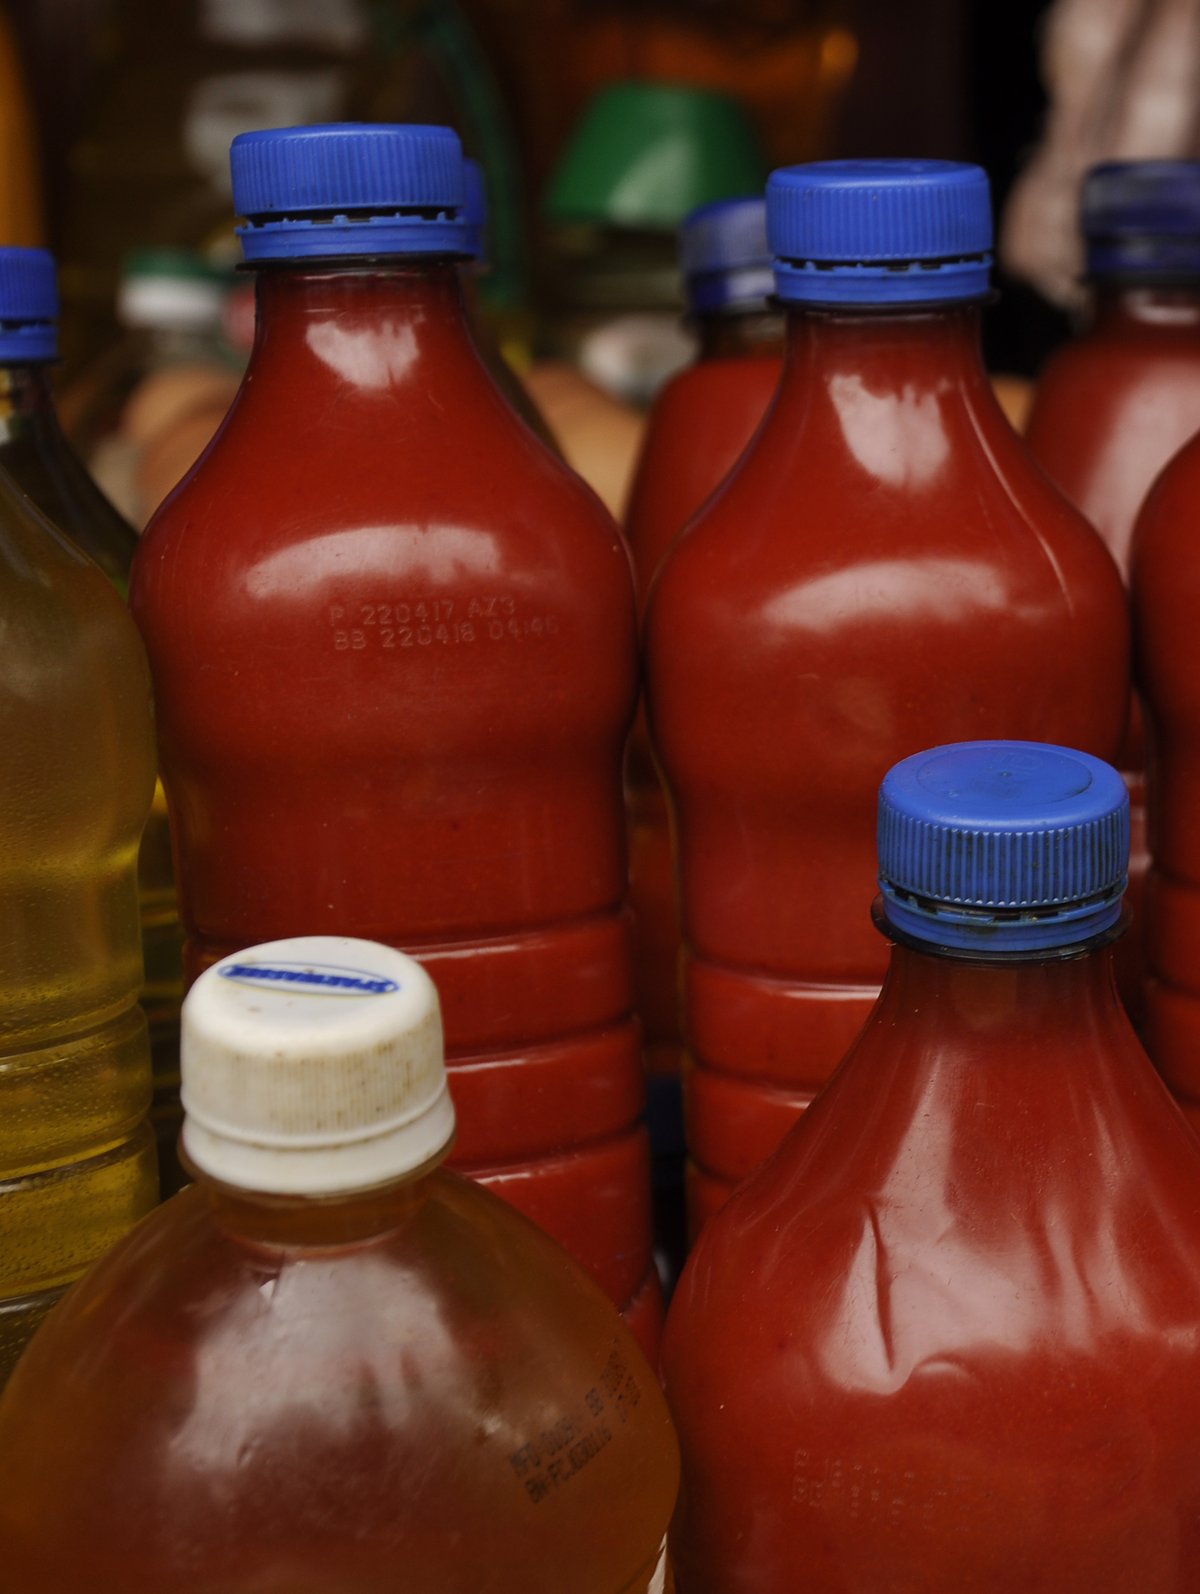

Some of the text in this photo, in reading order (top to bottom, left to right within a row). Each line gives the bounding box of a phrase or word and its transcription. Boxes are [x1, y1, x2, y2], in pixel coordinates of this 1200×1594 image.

[329, 605, 345, 626] P
[360, 600, 455, 625] 220417
[334, 629, 368, 651] BB
[380, 622, 477, 648] 220418
